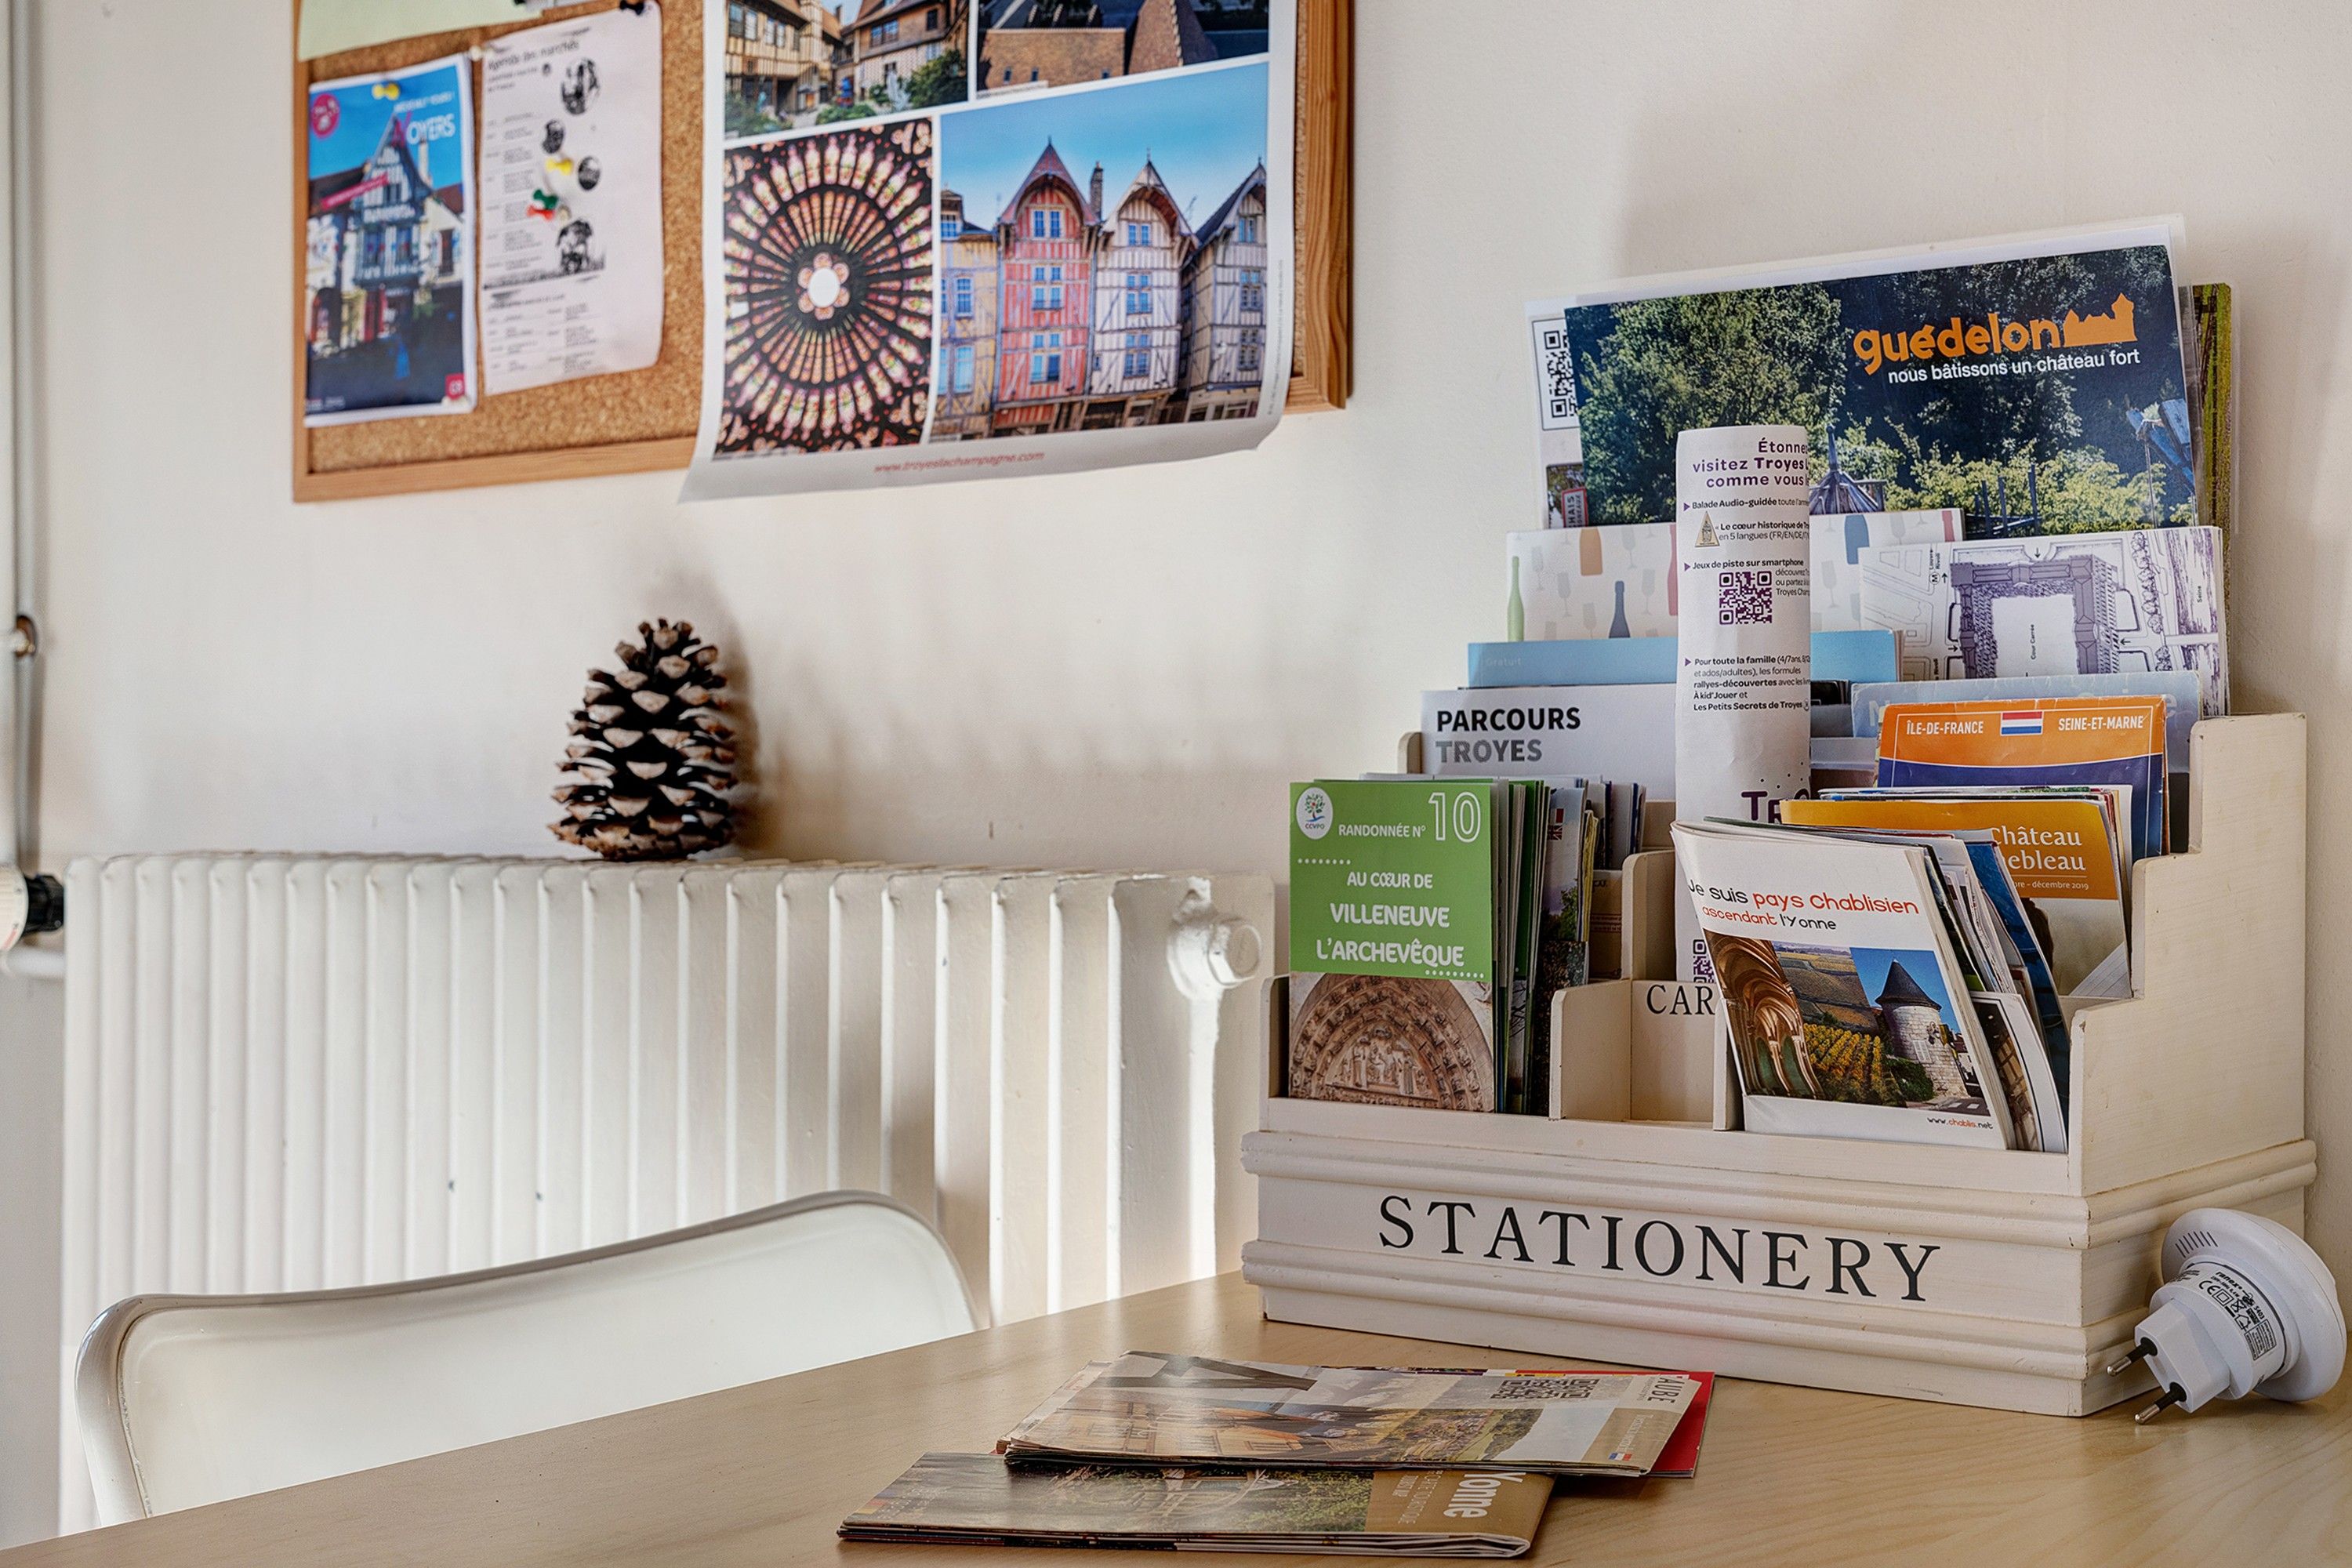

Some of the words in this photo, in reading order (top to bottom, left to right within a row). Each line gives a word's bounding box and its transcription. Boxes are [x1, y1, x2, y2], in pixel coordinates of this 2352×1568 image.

[1853, 311, 2061, 376] guédelon
[1888, 367, 1928, 383] nous
[1932, 359, 2008, 380] bâtissons
[2012, 361, 2032, 374] un
[2036, 352, 2105, 372] château
[2109, 350, 2141, 365] fort
[1693, 458, 1748, 473] visitez
[1754, 457, 1804, 472] Troyes
[1707, 476, 1769, 488] comme
[1774, 475, 1804, 485] vous
[1719, 497, 1777, 508] Audio-guidée
[1757, 521, 1796, 530] historique
[1737, 532, 1768, 542] langues
[1723, 559, 1744, 569] piste
[1762, 558, 1804, 568] smartphone
[1712, 657, 1735, 666] toute
[1746, 655, 1776, 664] famille
[1693, 679, 1777, 688] rallyes-découvertes
[1733, 702, 1767, 710] Secrets
[1780, 701, 1802, 710] Troyes
[1436, 707, 1581, 732] PARCOURS
[1906, 719, 1984, 735] ÎLE-DE-FRANCE
[2058, 714, 2143, 732] SEINE-ET-MARNE
[1436, 739, 1542, 764] TROYES
[1338, 822, 1410, 837] RANDONNÉE
[1412, 825, 1427, 837] N°
[1428, 791, 1481, 843] 10
[2008, 849, 2086, 870] ebleau
[1347, 872, 1367, 887] AU
[1370, 872, 1411, 888] CŒUR
[1414, 873, 1433, 889] DE
[1688, 879, 1704, 896] Je
[1709, 887, 1749, 904] suis
[1752, 891, 1805, 912] pays
[1330, 902, 1450, 927] VILLENEUVE
[1702, 905, 1777, 926] ascendant
[1316, 938, 1465, 967] L'ARCHEVÊQUE
[1927, 1117, 1993, 1129] www.chablis.net
[1378, 1195, 1941, 1302] STATIONERY
[2198, 1280, 2221, 1295] CE
[1647, 1377, 1686, 1403] AUBE
[1443, 1472, 1526, 1519] Yonne
